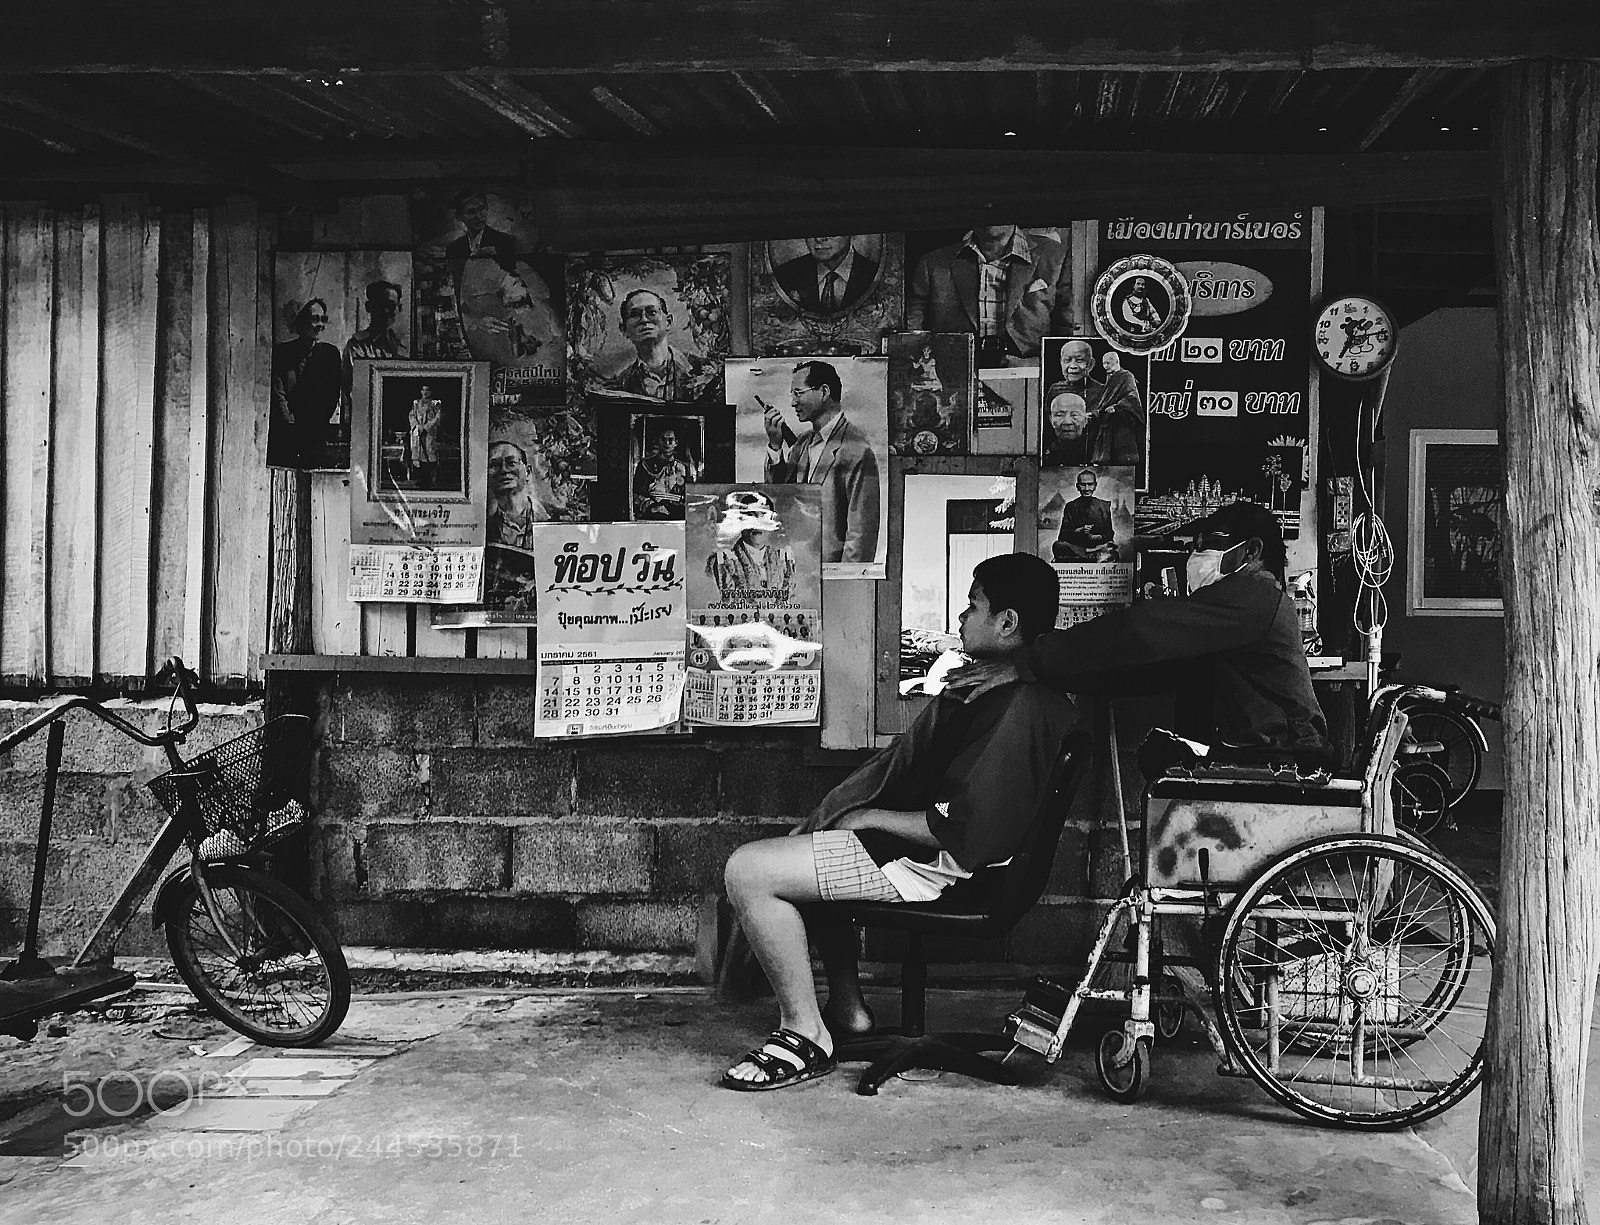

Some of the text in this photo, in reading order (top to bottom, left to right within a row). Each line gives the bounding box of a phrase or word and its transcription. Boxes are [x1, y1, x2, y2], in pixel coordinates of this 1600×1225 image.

[1329, 307, 1339, 316] 11
[1319, 320, 1331, 328] 10
[1229, 338, 1286, 361] บาท
[1245, 391, 1301, 414] บาท
[554, 542, 676, 583] ท็อป วัน
[351, 567, 356, 575] 1
[594, 665, 601, 673] 2
[615, 664, 623, 672] 3
[635, 664, 643, 672] 4
[656, 663, 664, 671] 5
[552, 677, 560, 686] 7
[573, 676, 580, 685] 8
[594, 675, 601, 684] 9
[606, 675, 622, 684] 10
[628, 674, 641, 683] 11
[649, 674, 664, 682] 12
[544, 688, 559, 696] 14
[565, 687, 580, 696] 15
[586, 686, 601, 695] 16
[606, 686, 622, 695] 17
[628, 685, 643, 694] 18
[649, 684, 663, 693] 19
[686, 690, 692, 698] 1
[543, 695, 662, 708] 21 22 23 24 25 26
[774, 702, 785, 710] 25
[543, 708, 619, 719] 28 29 30 31
